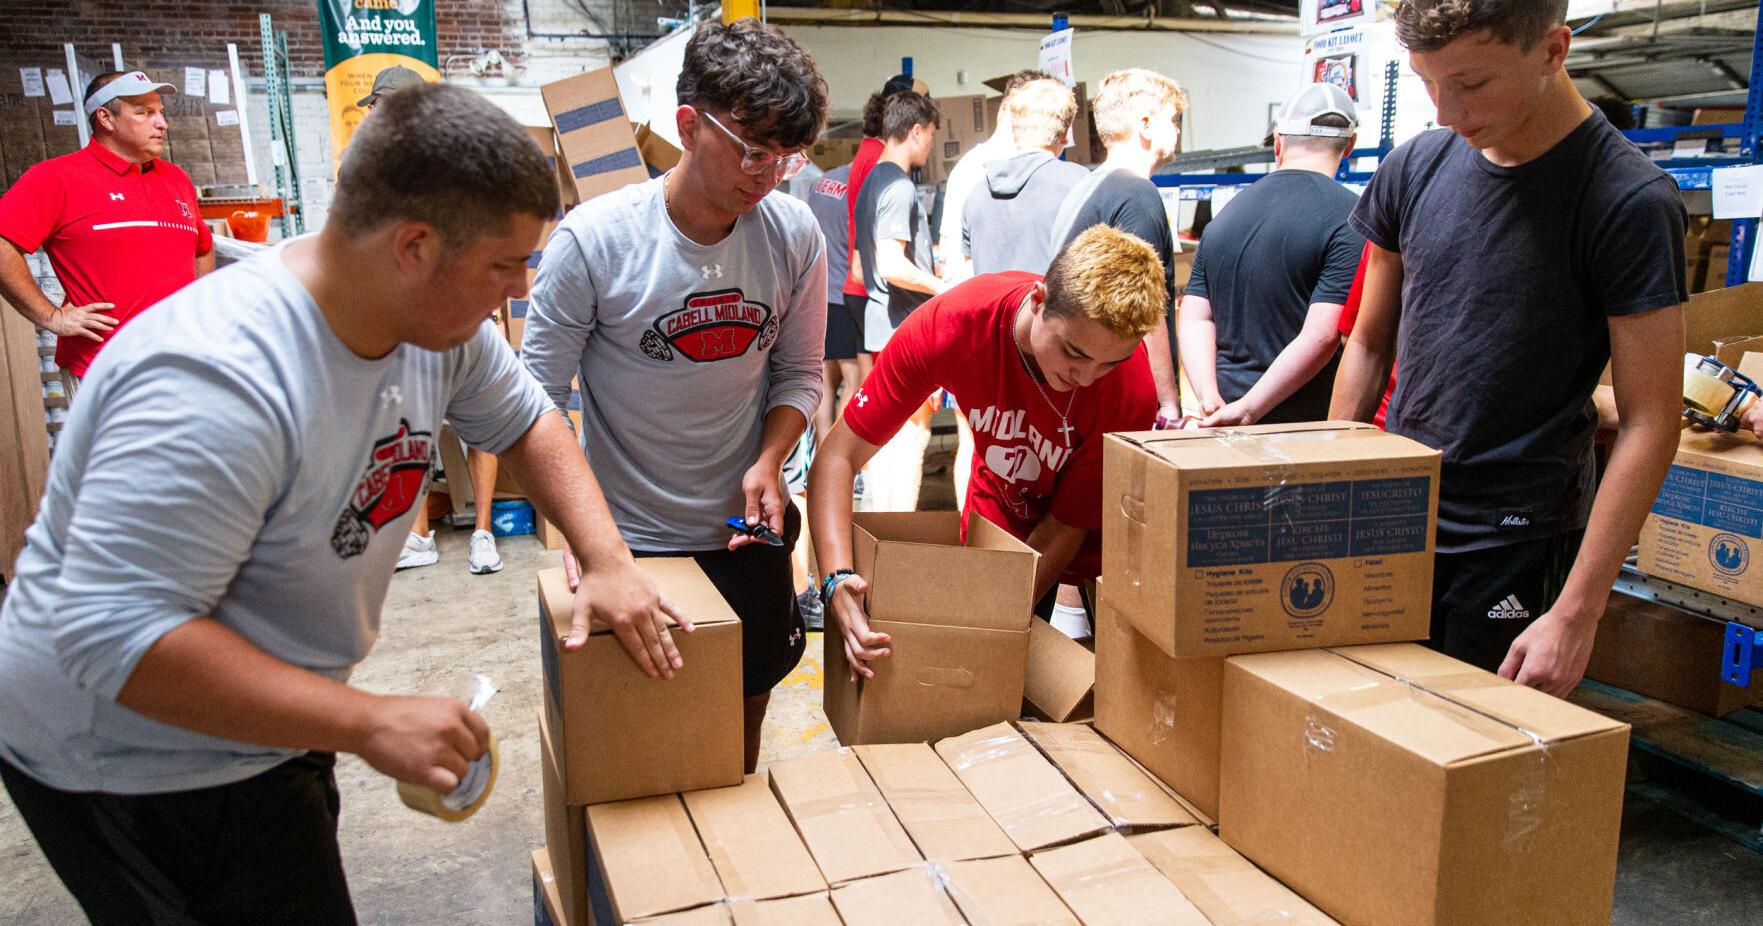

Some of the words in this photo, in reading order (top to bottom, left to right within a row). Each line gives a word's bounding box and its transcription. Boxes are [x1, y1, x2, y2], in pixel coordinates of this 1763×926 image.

[345, 15, 382, 31] And
[384, 18, 416, 34] you
[337, 30, 426, 46] answered.
[815, 178, 848, 200] TEAM
[667, 307, 713, 336] CABELL
[714, 304, 761, 326] MIDLAND
[1360, 487, 1423, 500] JESUCRISTO
[1190, 502, 1223, 514] JESUS
[1499, 514, 1531, 526] Hollister
[1355, 527, 1385, 541] JESUS
[1387, 525, 1425, 538] CRISTO
[1206, 570, 1236, 578] Hygiene
[1487, 609, 1530, 619] adidas
